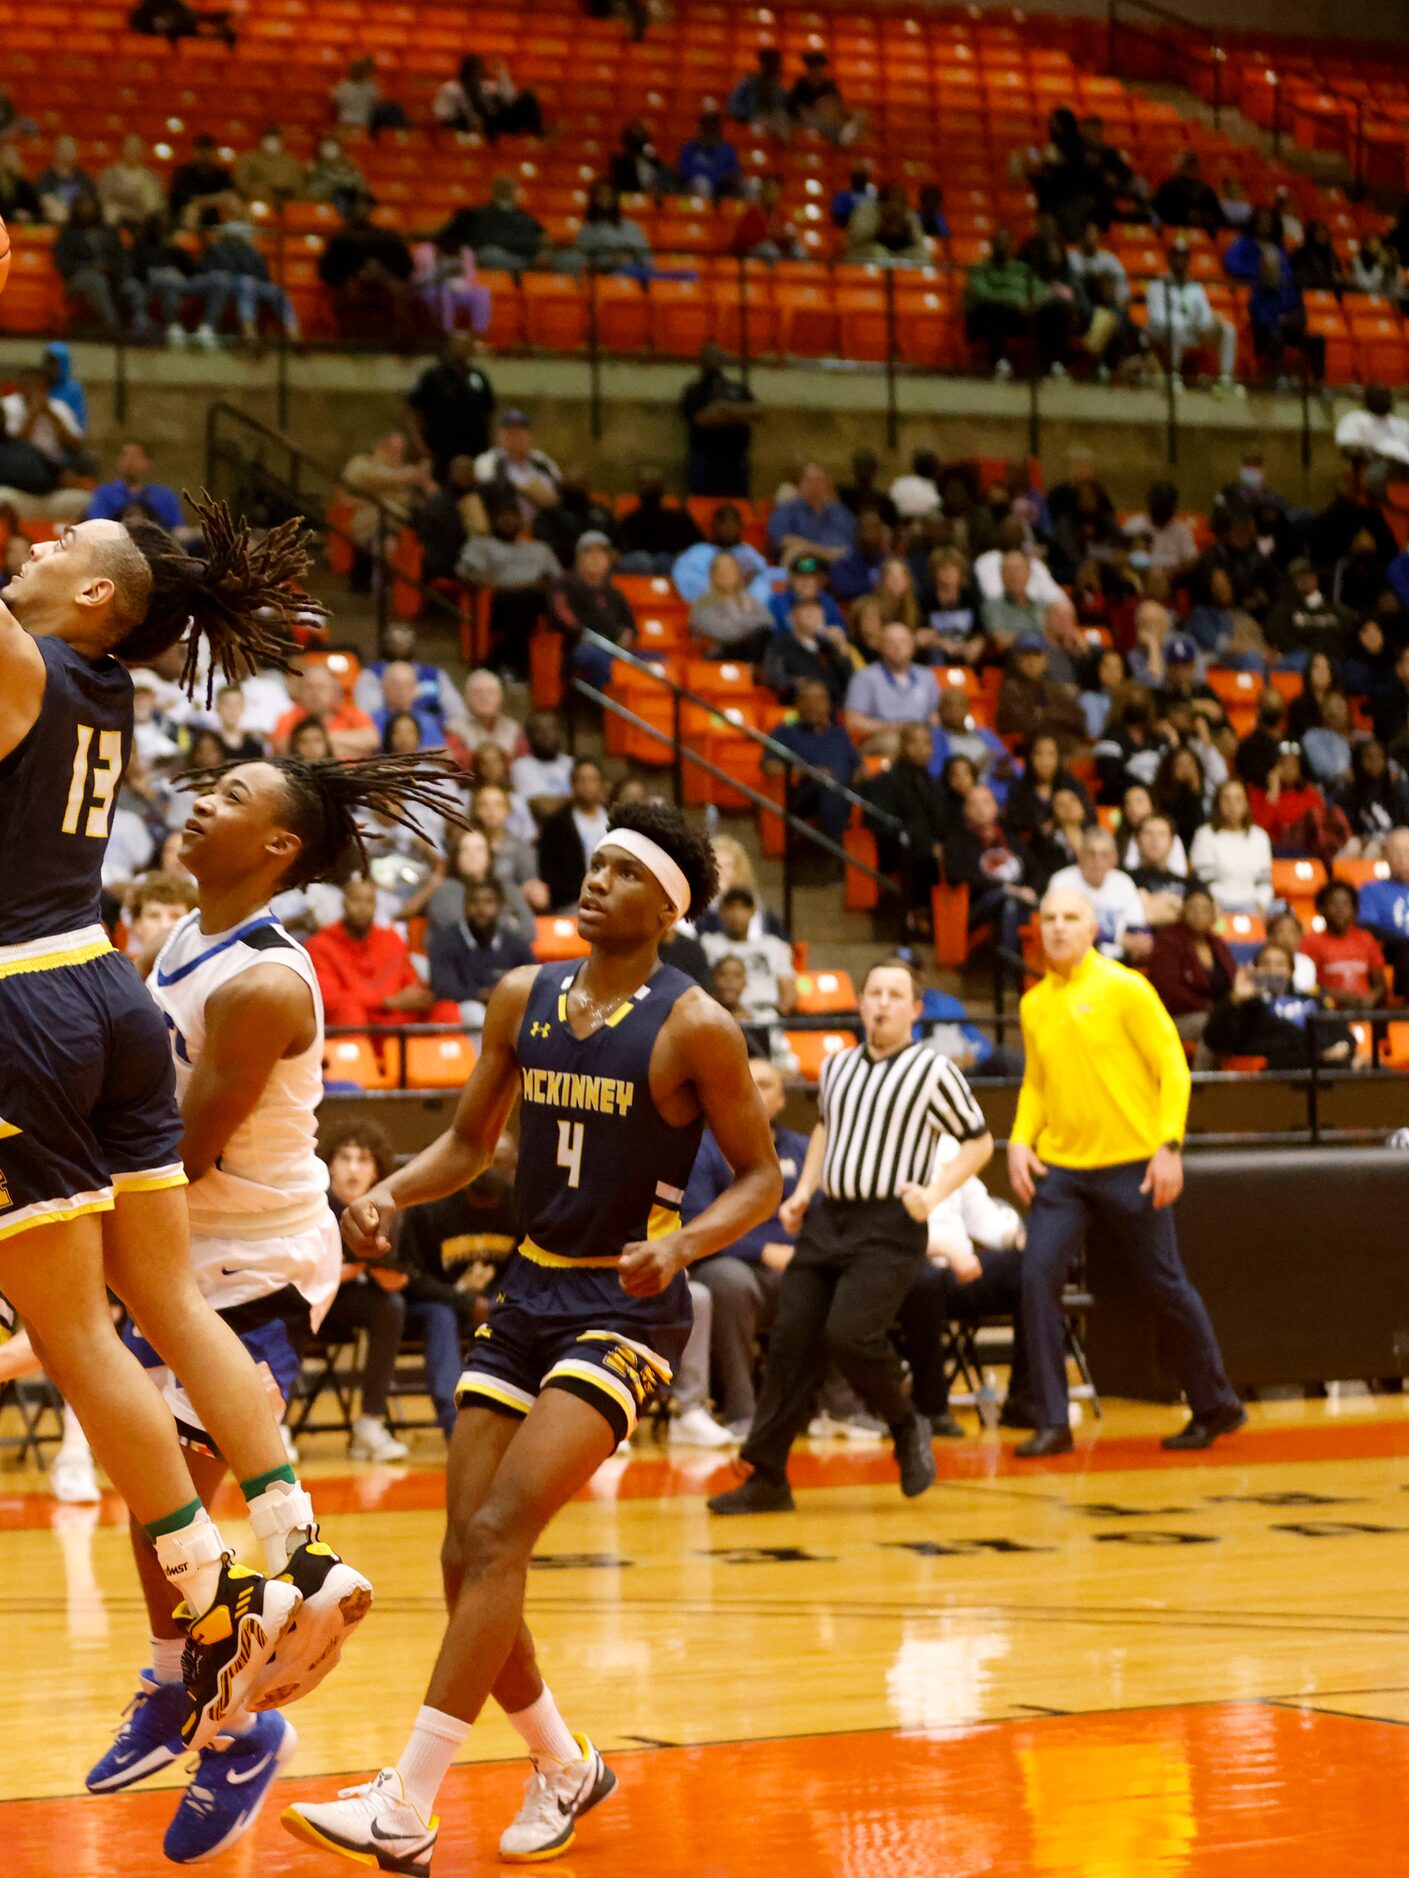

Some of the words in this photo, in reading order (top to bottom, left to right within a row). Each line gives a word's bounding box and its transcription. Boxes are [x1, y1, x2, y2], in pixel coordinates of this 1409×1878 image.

[61, 723, 123, 838] 13
[522, 1066, 635, 1117] MCKINNEY
[556, 1120, 585, 1188] 4
